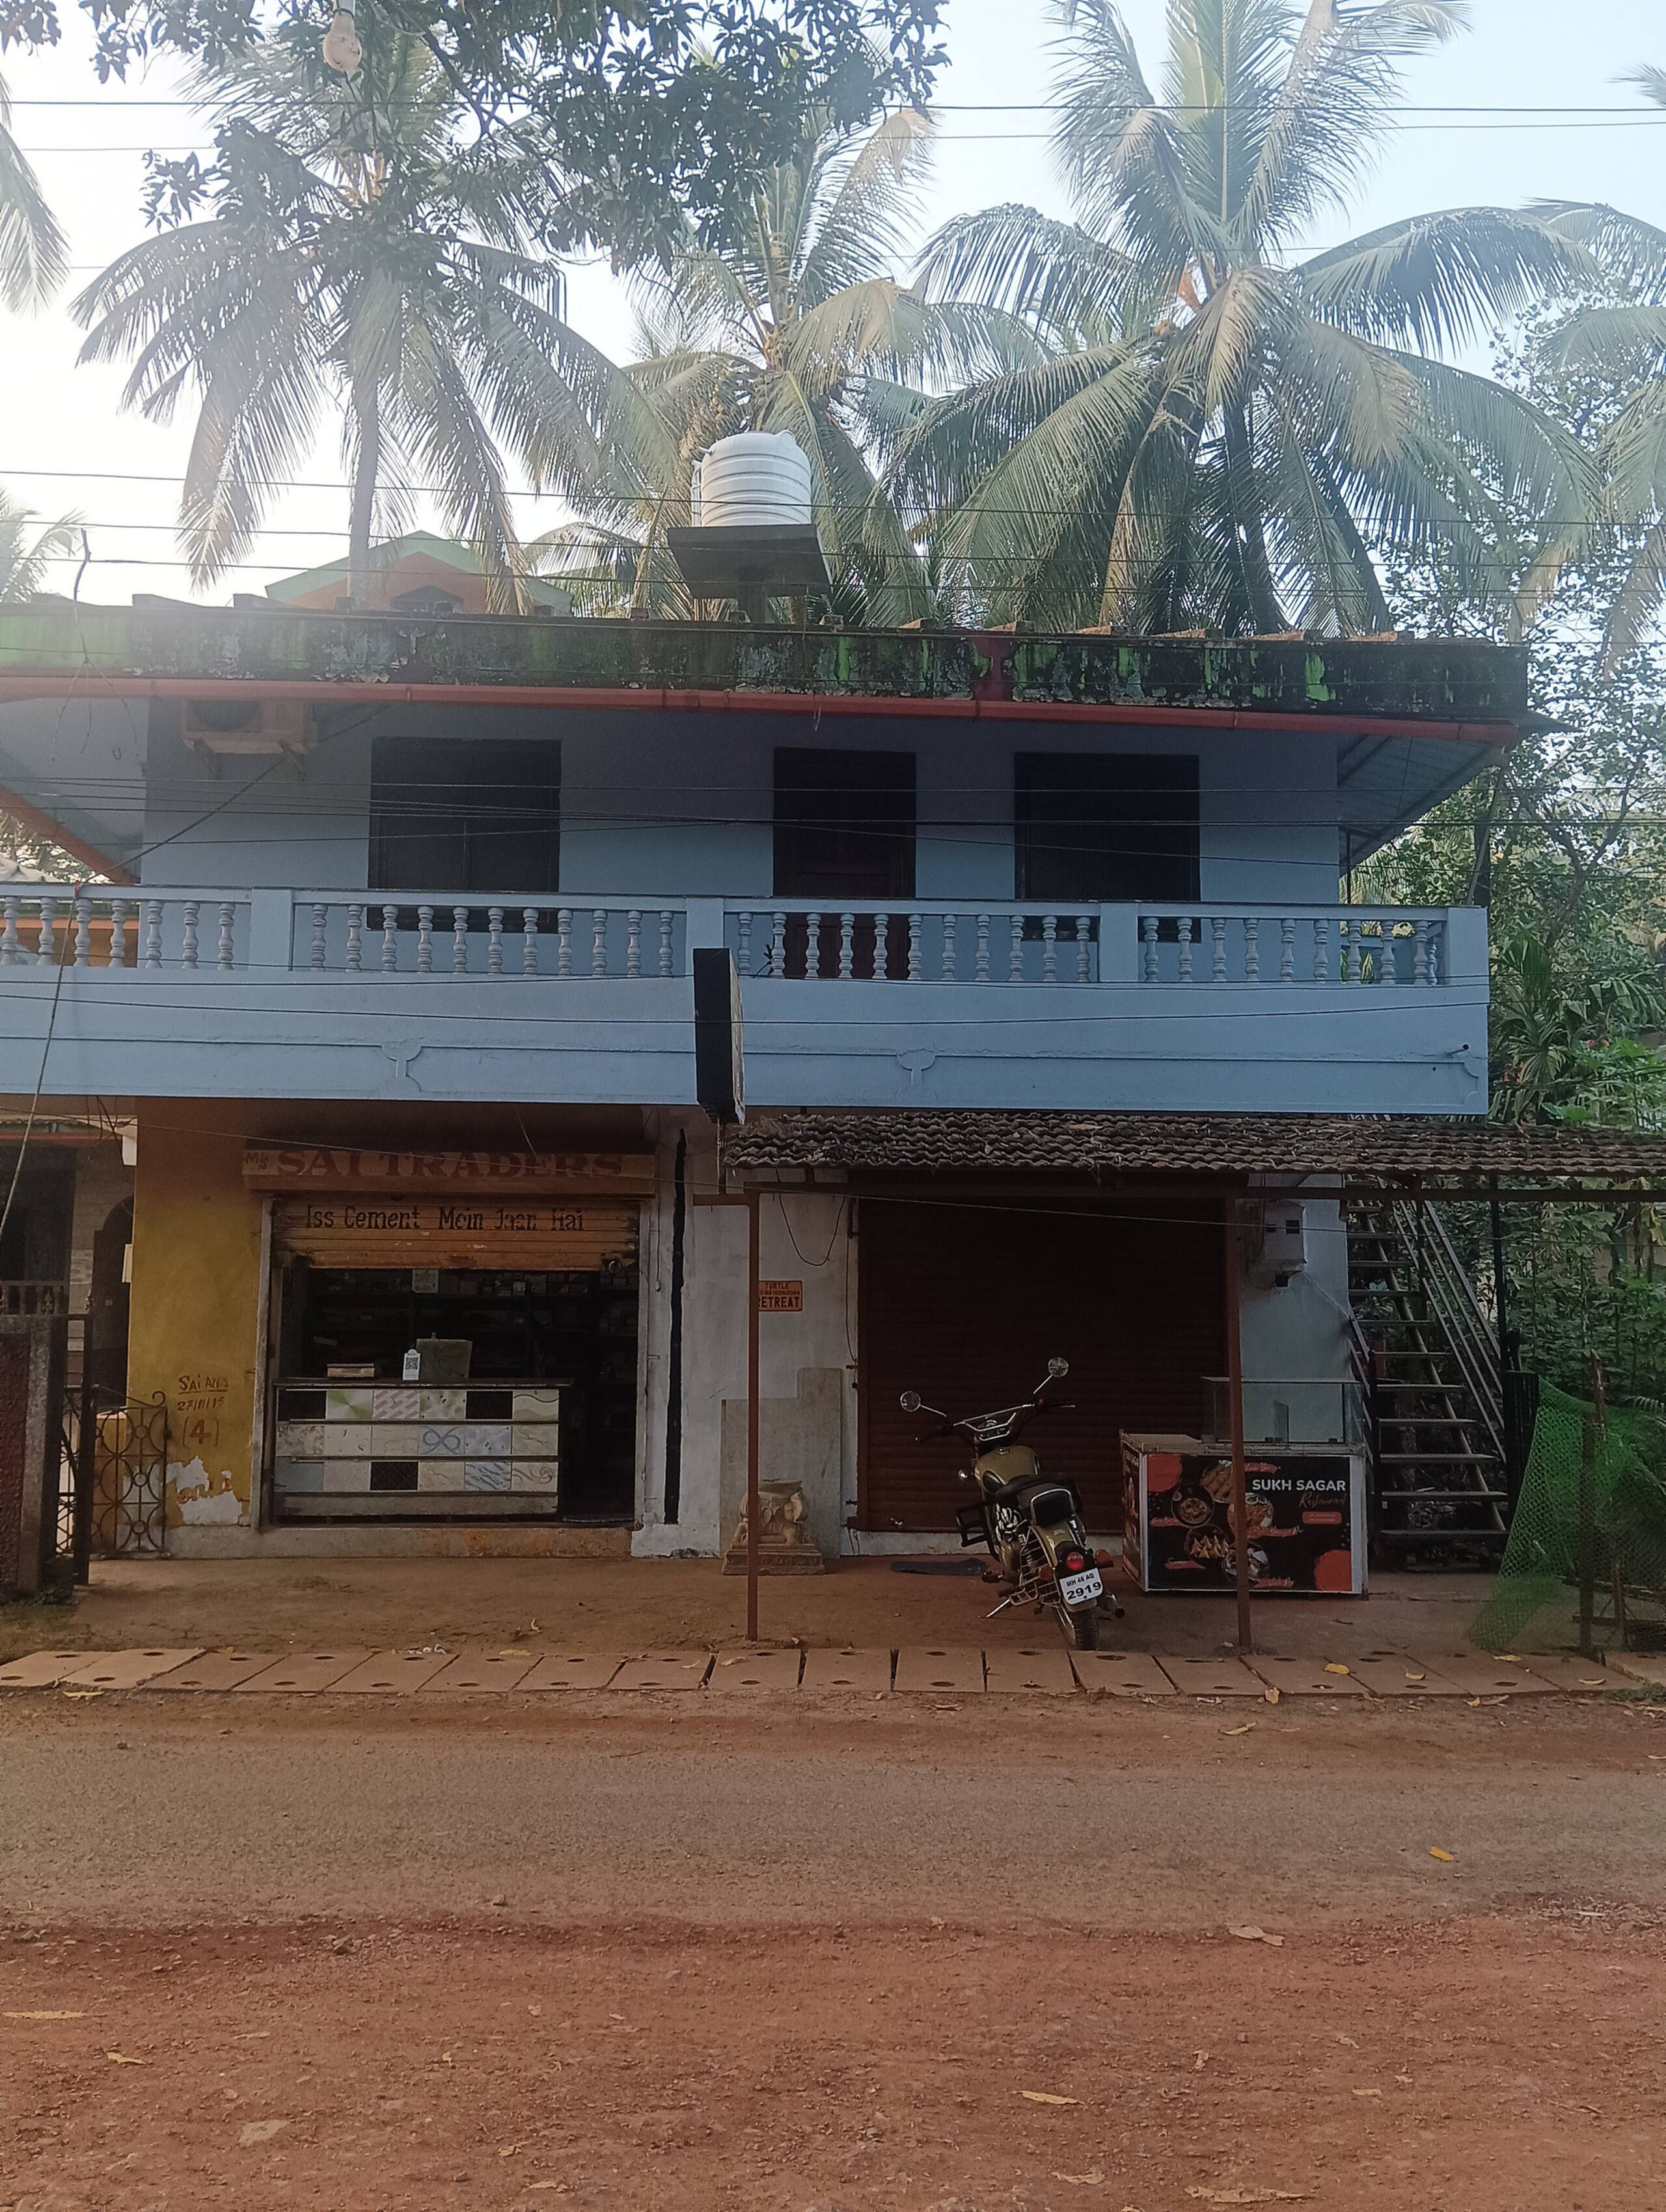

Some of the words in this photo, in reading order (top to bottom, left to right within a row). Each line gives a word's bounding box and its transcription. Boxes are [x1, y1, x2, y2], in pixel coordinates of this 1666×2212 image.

[379, 1151, 623, 1179] TRADERS
[306, 1205, 335, 1228] Iss
[344, 1205, 420, 1229] Cement
[438, 1206, 484, 1230] Mein
[551, 1207, 584, 1231] Hai
[1252, 1479, 1292, 1491] SUKH
[1296, 1480, 1346, 1492] SAGAR
[1067, 1581, 1102, 1600] 2919
